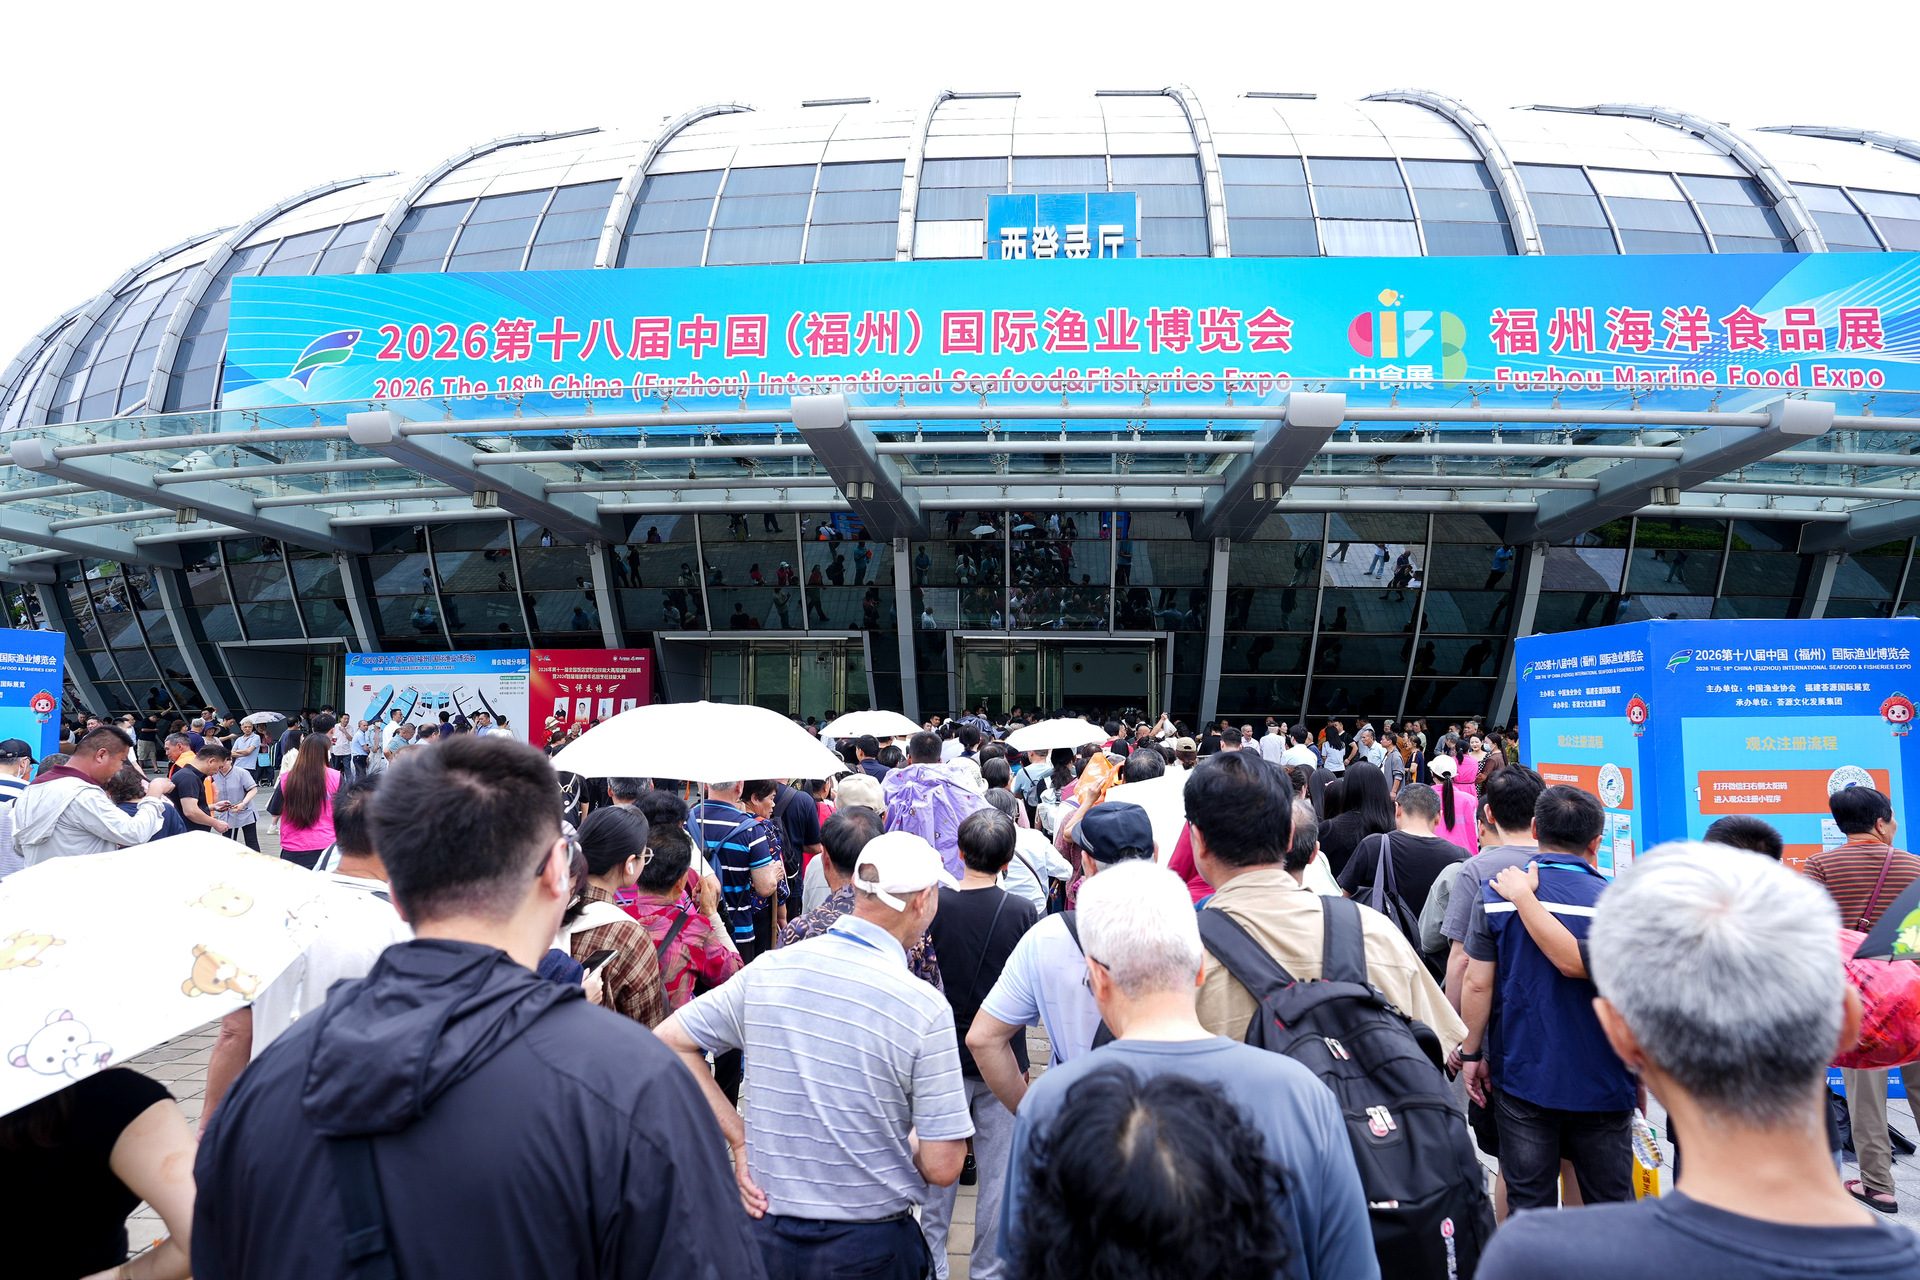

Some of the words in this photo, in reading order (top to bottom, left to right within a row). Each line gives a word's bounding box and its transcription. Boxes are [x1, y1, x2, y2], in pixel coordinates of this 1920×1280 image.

[375, 305, 1293, 363] 2026第十八届中国（福州）国际渔业博览会
[1490, 305, 1885, 354] 福州海洋食品展
[373, 376, 433, 399] 2026
[443, 376, 488, 400] The
[496, 374, 543, 399] 18th
[549, 373, 623, 399] China
[632, 370, 749, 402] (Fuzhou)
[759, 368, 944, 396] International
[951, 367, 1214, 394] Seafood&Fisheries
[1223, 367, 1293, 396] Expo
[1349, 364, 1434, 390] 中食展
[1496, 366, 1602, 391] Fuzhou
[1614, 364, 1716, 391] Marine
[1728, 363, 1799, 388] Food
[1811, 364, 1885, 389] Expo
[0, 652, 56, 665] 国际渔业博览会
[1695, 648, 1910, 662] 2026第十八届中国（福州）国际渔业博览会
[1745, 736, 1839, 751] 观众注册流程
[1694, 787, 1701, 800] 1
[1714, 795, 1782, 803] 进入观众注册小程序
